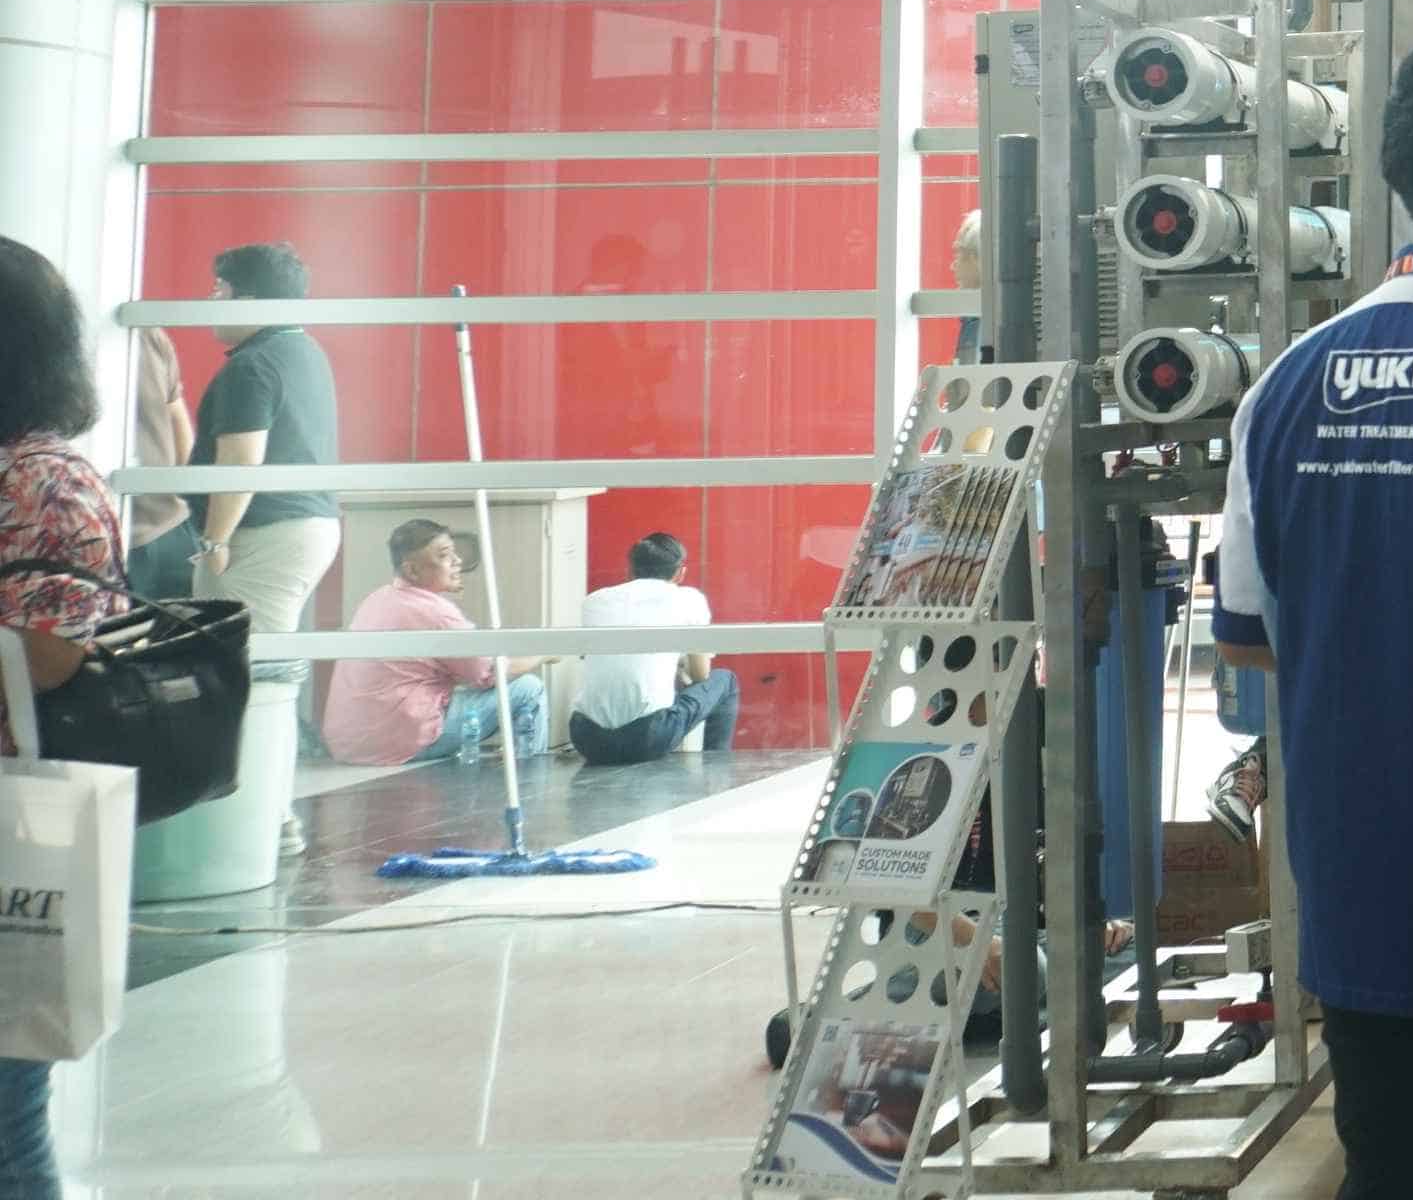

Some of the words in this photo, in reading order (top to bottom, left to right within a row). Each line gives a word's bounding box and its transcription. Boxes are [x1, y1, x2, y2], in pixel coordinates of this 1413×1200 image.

[1317, 423, 1357, 439] WATER
[862, 847, 901, 859] CUSTOM
[856, 859, 929, 875] SOLUTIONS
[0, 888, 66, 919] RT
